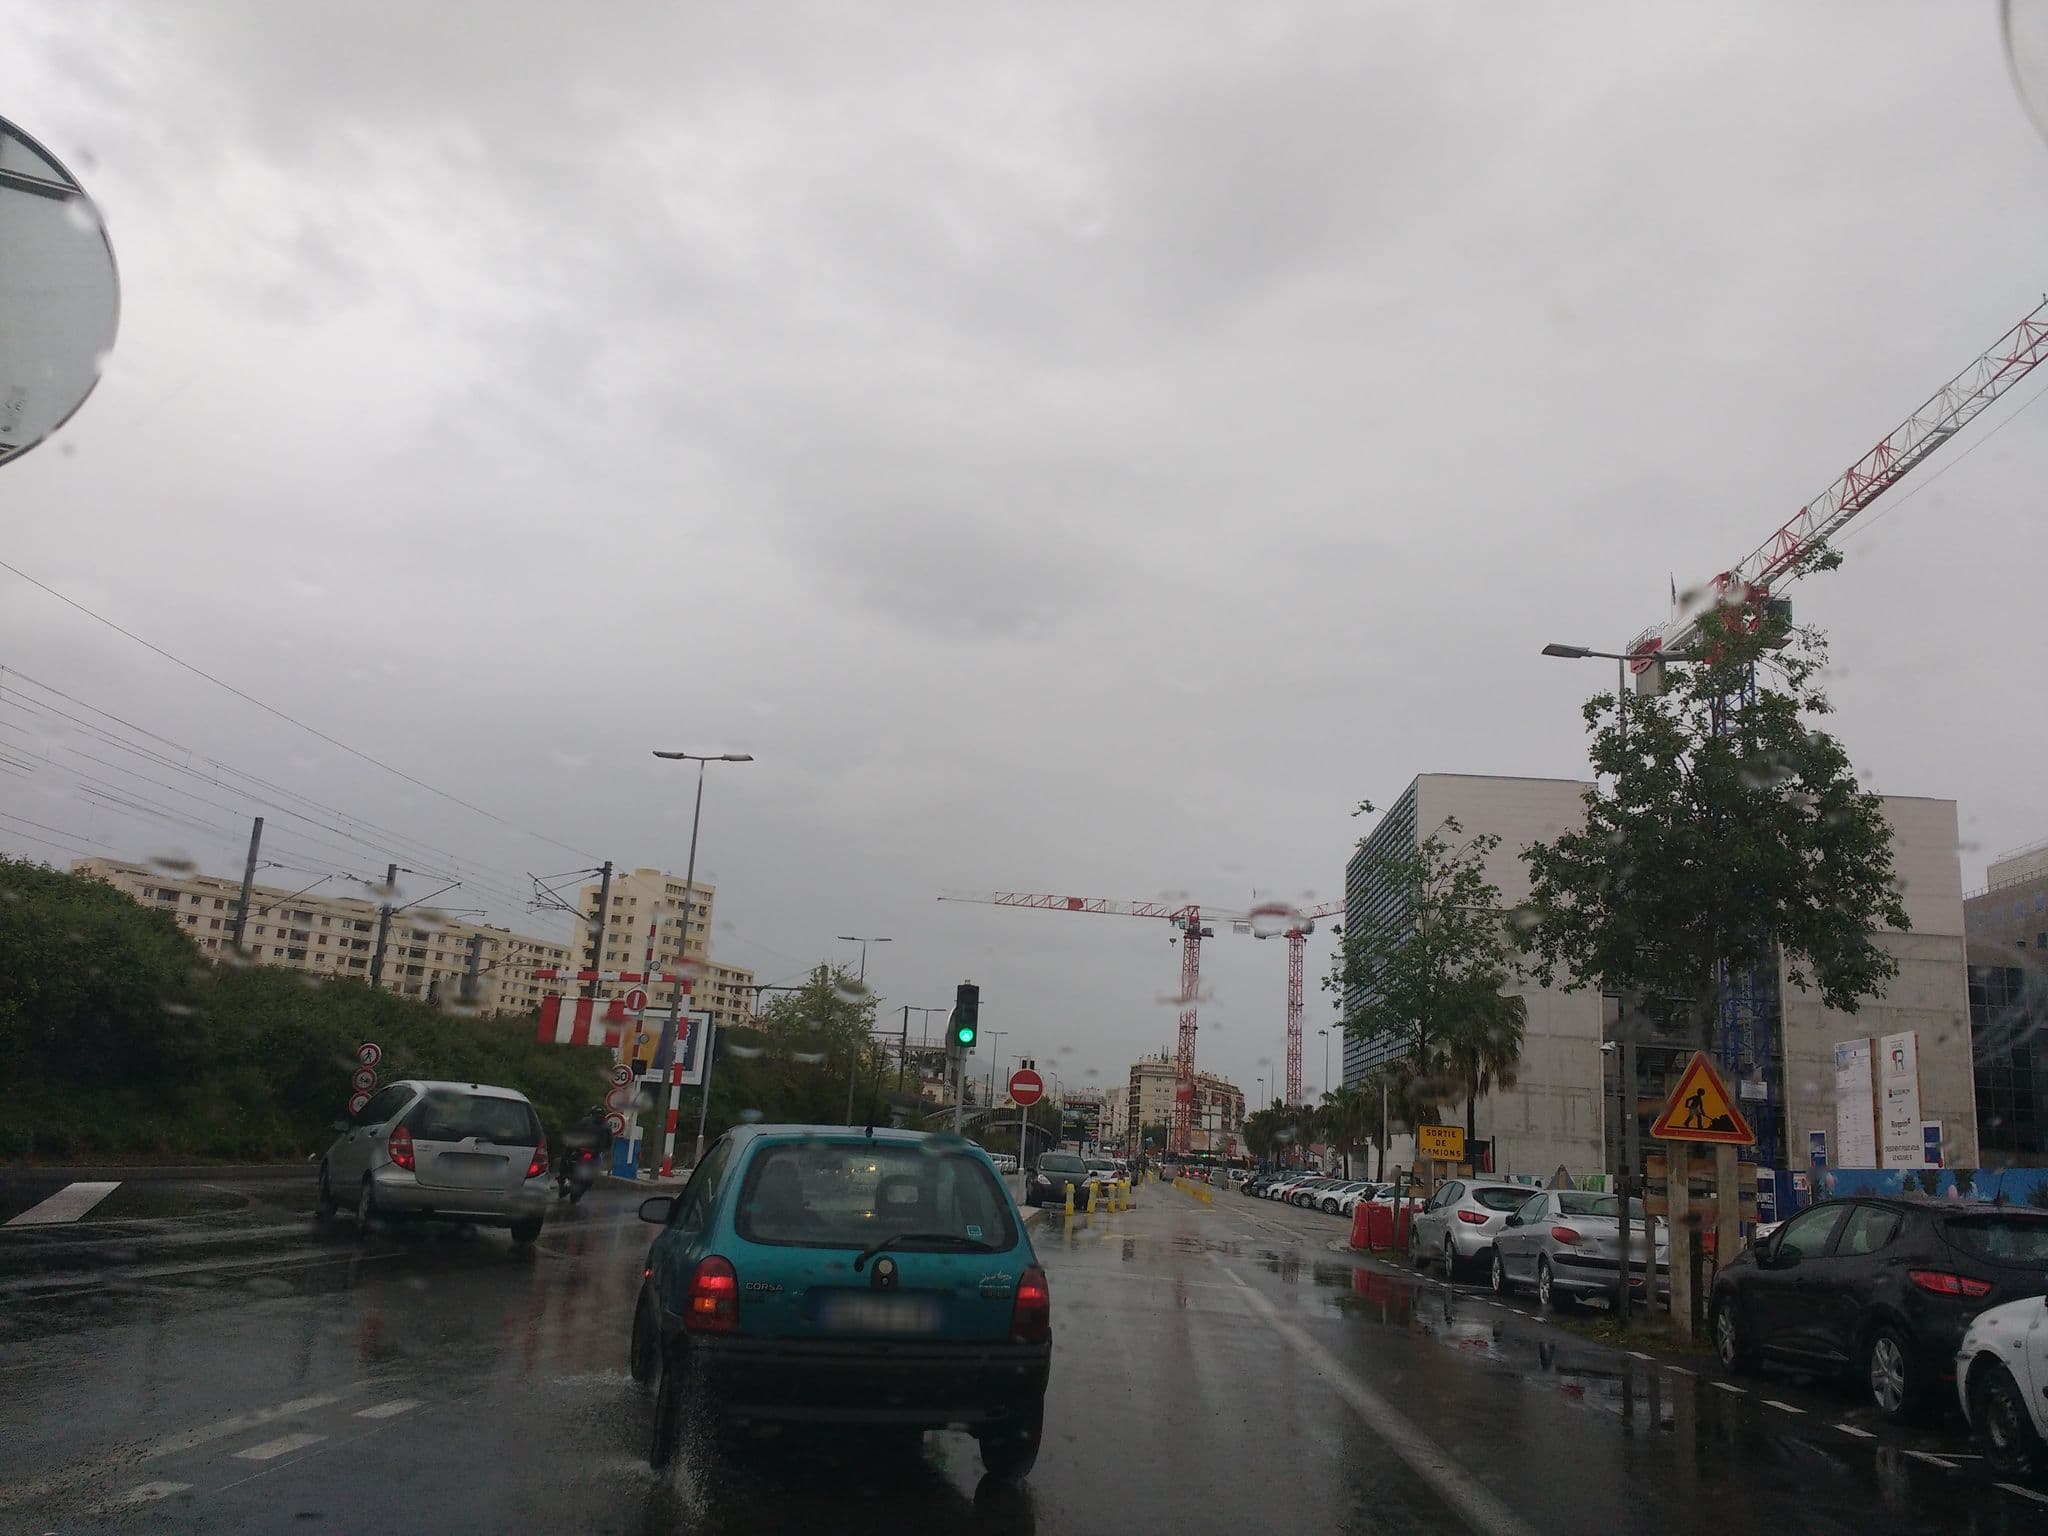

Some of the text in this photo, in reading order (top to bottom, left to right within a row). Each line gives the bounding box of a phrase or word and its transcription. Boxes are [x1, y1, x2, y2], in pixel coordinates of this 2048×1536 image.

[614, 1071, 627, 1081] 50
[1426, 1128, 1457, 1138] SORTIE
[1435, 1139, 1447, 1147] DE
[745, 1281, 784, 1291] CORSA
